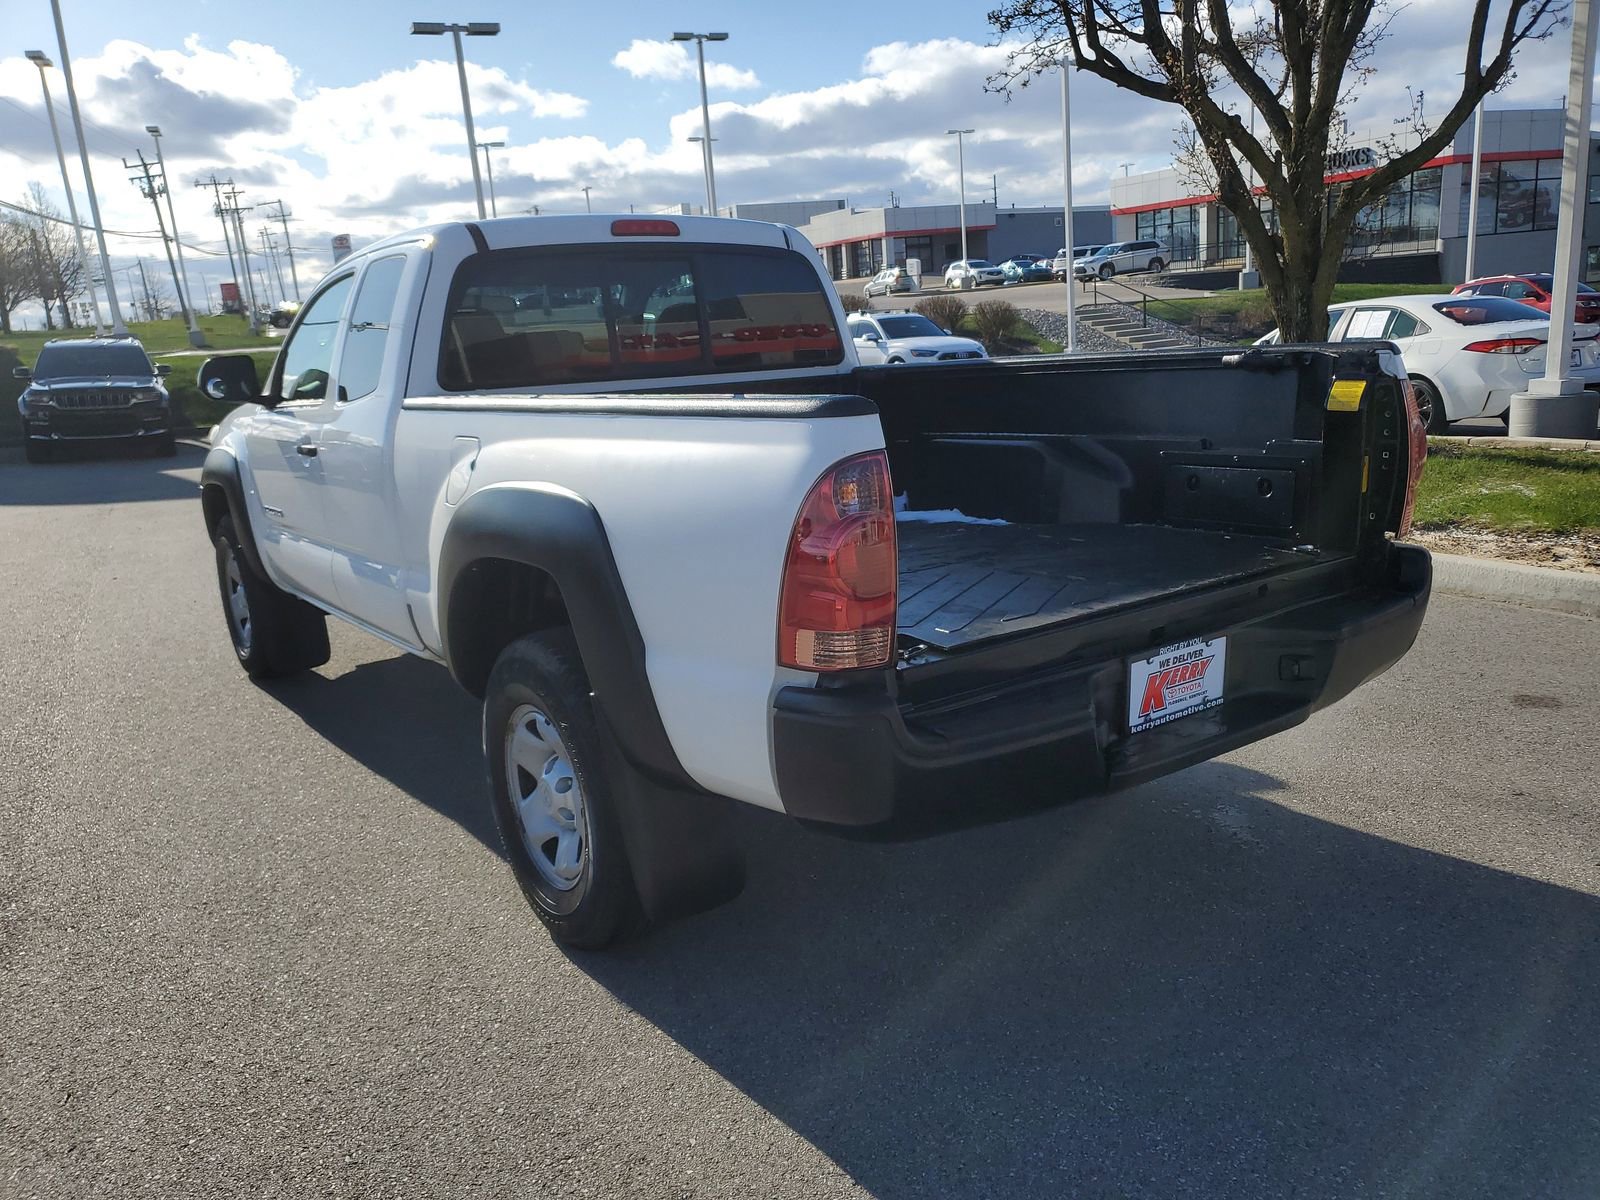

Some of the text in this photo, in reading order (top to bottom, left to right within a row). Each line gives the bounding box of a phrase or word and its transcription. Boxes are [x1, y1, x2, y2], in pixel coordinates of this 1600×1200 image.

[1160, 637, 1203, 655] RIGHT BY YOU
[1159, 649, 1203, 669] WE DELIVER
[1138, 655, 1215, 718] KERRY
[1177, 682, 1202, 693] TOYOTA
[1131, 697, 1224, 734] kerryautomotive.com
